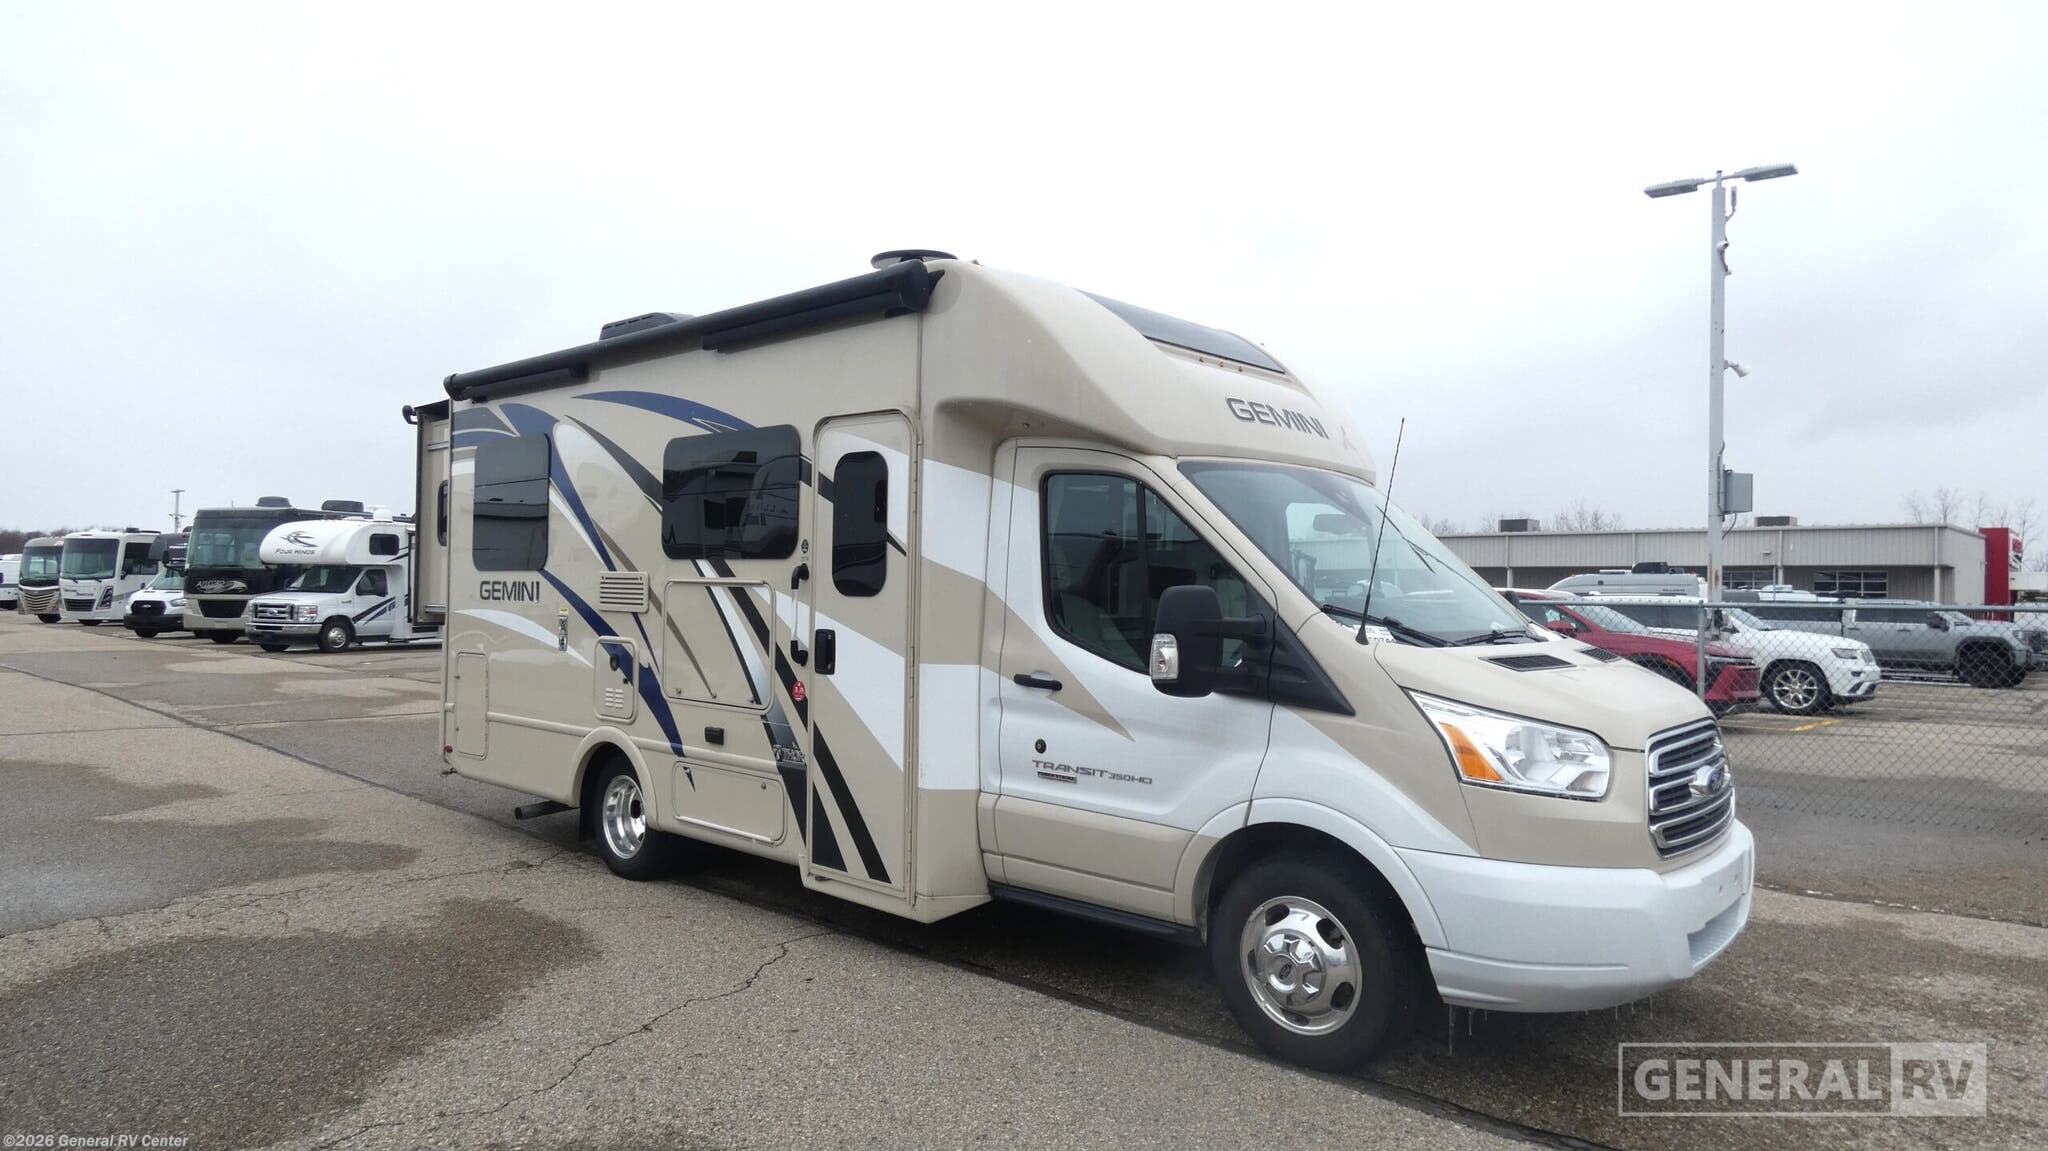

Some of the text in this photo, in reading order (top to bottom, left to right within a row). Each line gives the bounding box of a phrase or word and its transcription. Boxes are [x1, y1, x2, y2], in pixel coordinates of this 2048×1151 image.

[1225, 397, 1330, 440] GEMINI
[480, 580, 540, 602] GEMINI
[1032, 759, 1109, 778] TRANSIT
